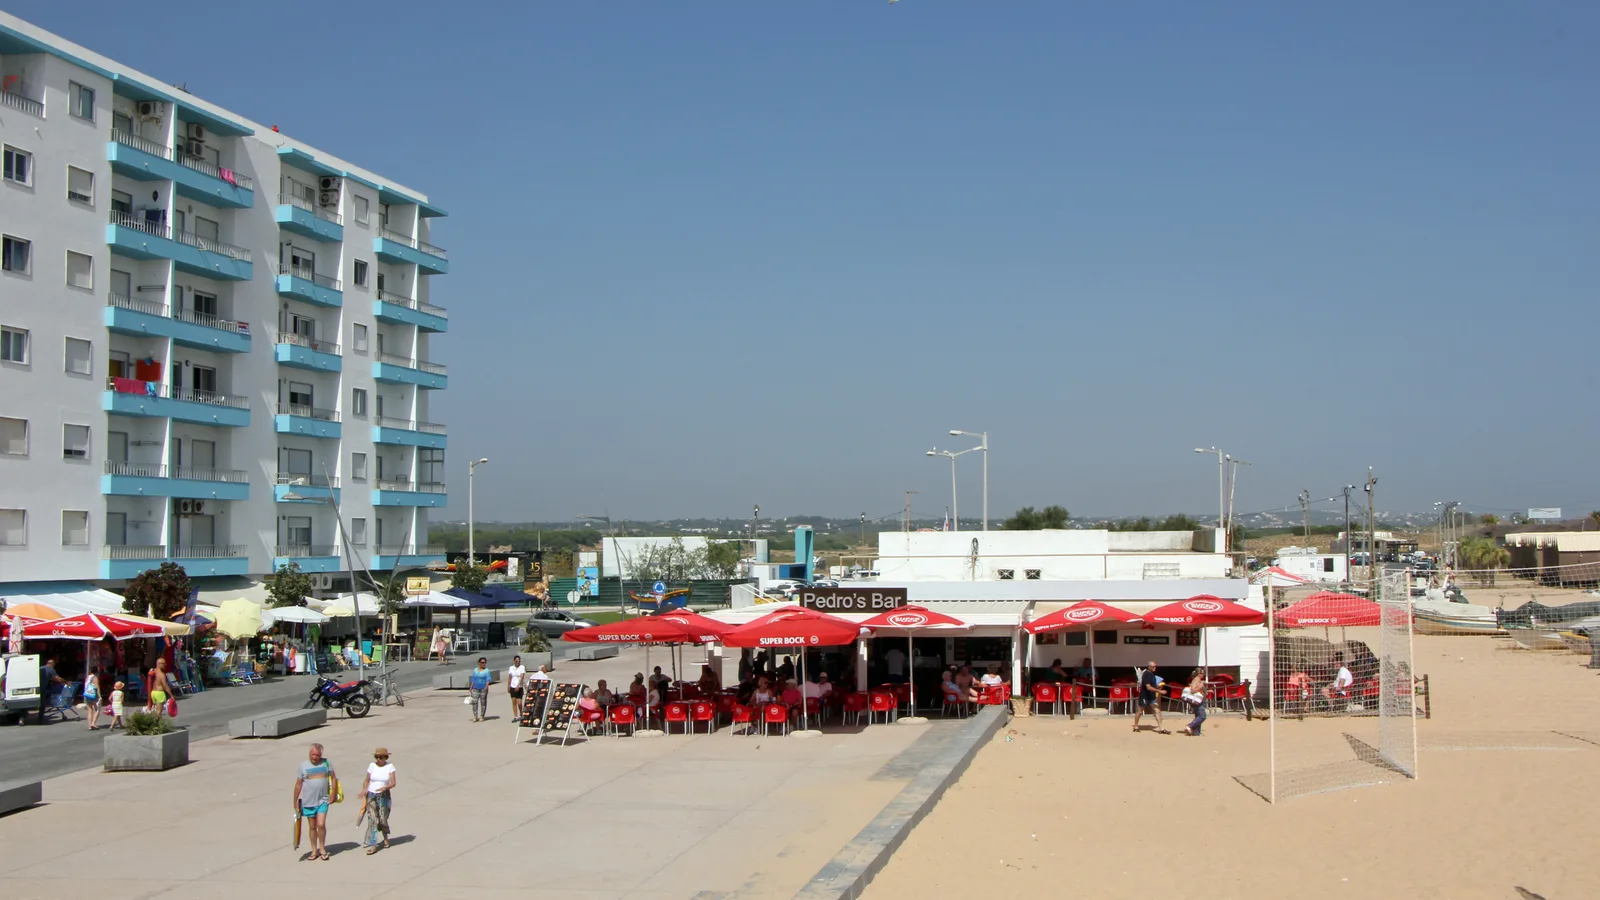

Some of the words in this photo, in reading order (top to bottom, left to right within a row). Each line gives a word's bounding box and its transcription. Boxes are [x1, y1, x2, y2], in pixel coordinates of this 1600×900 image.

[530, 562, 540, 573] 15
[803, 593, 866, 609] Pedro's
[871, 593, 902, 609] Bar
[760, 637, 783, 645] SUPER
[784, 636, 805, 644] BOCK
